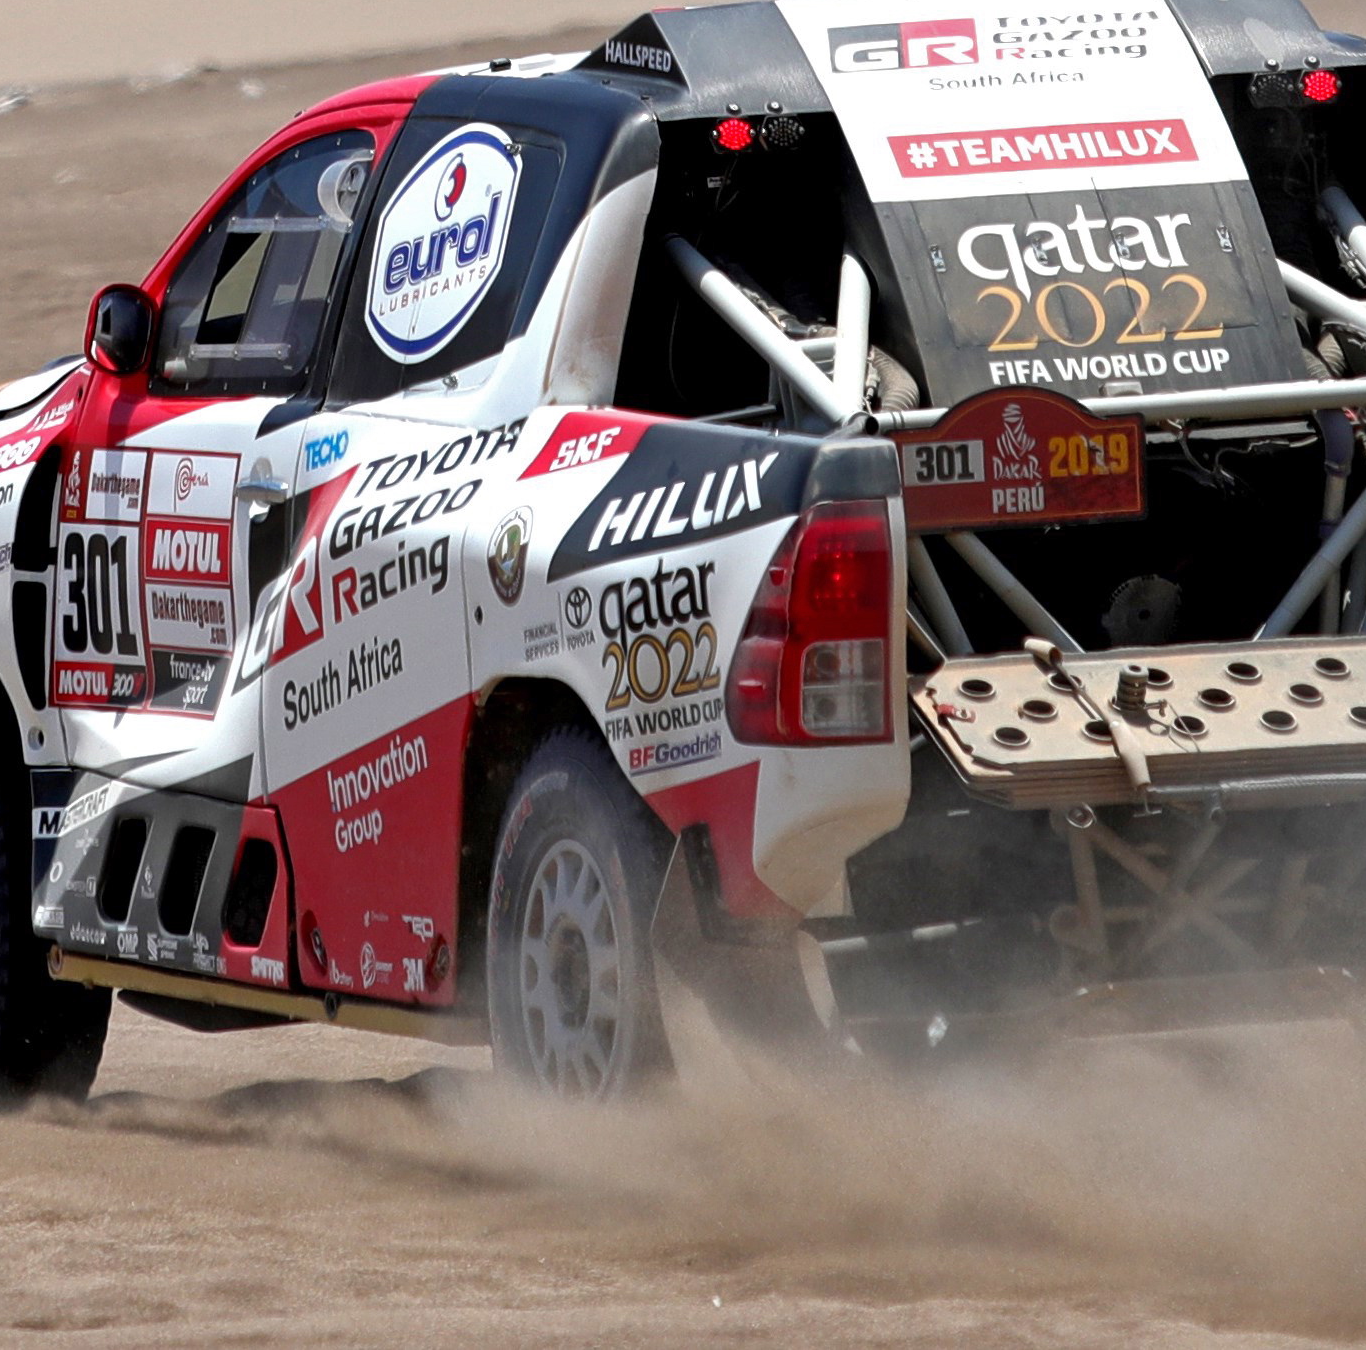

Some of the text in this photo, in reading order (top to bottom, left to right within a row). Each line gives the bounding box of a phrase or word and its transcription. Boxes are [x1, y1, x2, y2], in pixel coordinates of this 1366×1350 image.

[993, 27, 1147, 44] GAZOO
[995, 10, 1160, 28] TOYOTA
[605, 39, 672, 73] HALLSPEED
[834, 34, 977, 72] GR
[996, 43, 1147, 59] Racing
[929, 70, 1085, 91] South Africa
[907, 127, 1181, 169] #TEAMHILUX
[383, 191, 503, 295] eurol
[957, 204, 1192, 303] qatar
[379, 265, 487, 317] LUBRICANTS
[977, 274, 1225, 352] 2022
[989, 349, 1231, 386] FIFA WORLD CUP
[354, 416, 530, 499] TOYOTA
[549, 426, 621, 472] SKF
[915, 445, 975, 483] 301
[1049, 433, 1130, 478] 2019
[91, 472, 140, 498] Dakarthegame
[588, 452, 780, 552] HILUX
[992, 482, 1045, 514] PERÚ
[329, 478, 483, 560] GAZOO
[152, 528, 221, 573] MOTUL
[63, 532, 139, 656] 301
[332, 534, 450, 625] Racing
[151, 591, 225, 629] Dakarthegame
[599, 558, 715, 651] qatar
[566, 630, 596, 650] TOYOTA
[58, 669, 108, 696] MOTUL
[283, 636, 403, 731] South Africa
[602, 621, 721, 712] 2022
[605, 698, 724, 742] FIFA WORLD CUP
[629, 732, 722, 769] BFGoodrich
[327, 734, 428, 814] Innovation
[335, 808, 383, 853] Group
[402, 957, 425, 992] 3M
